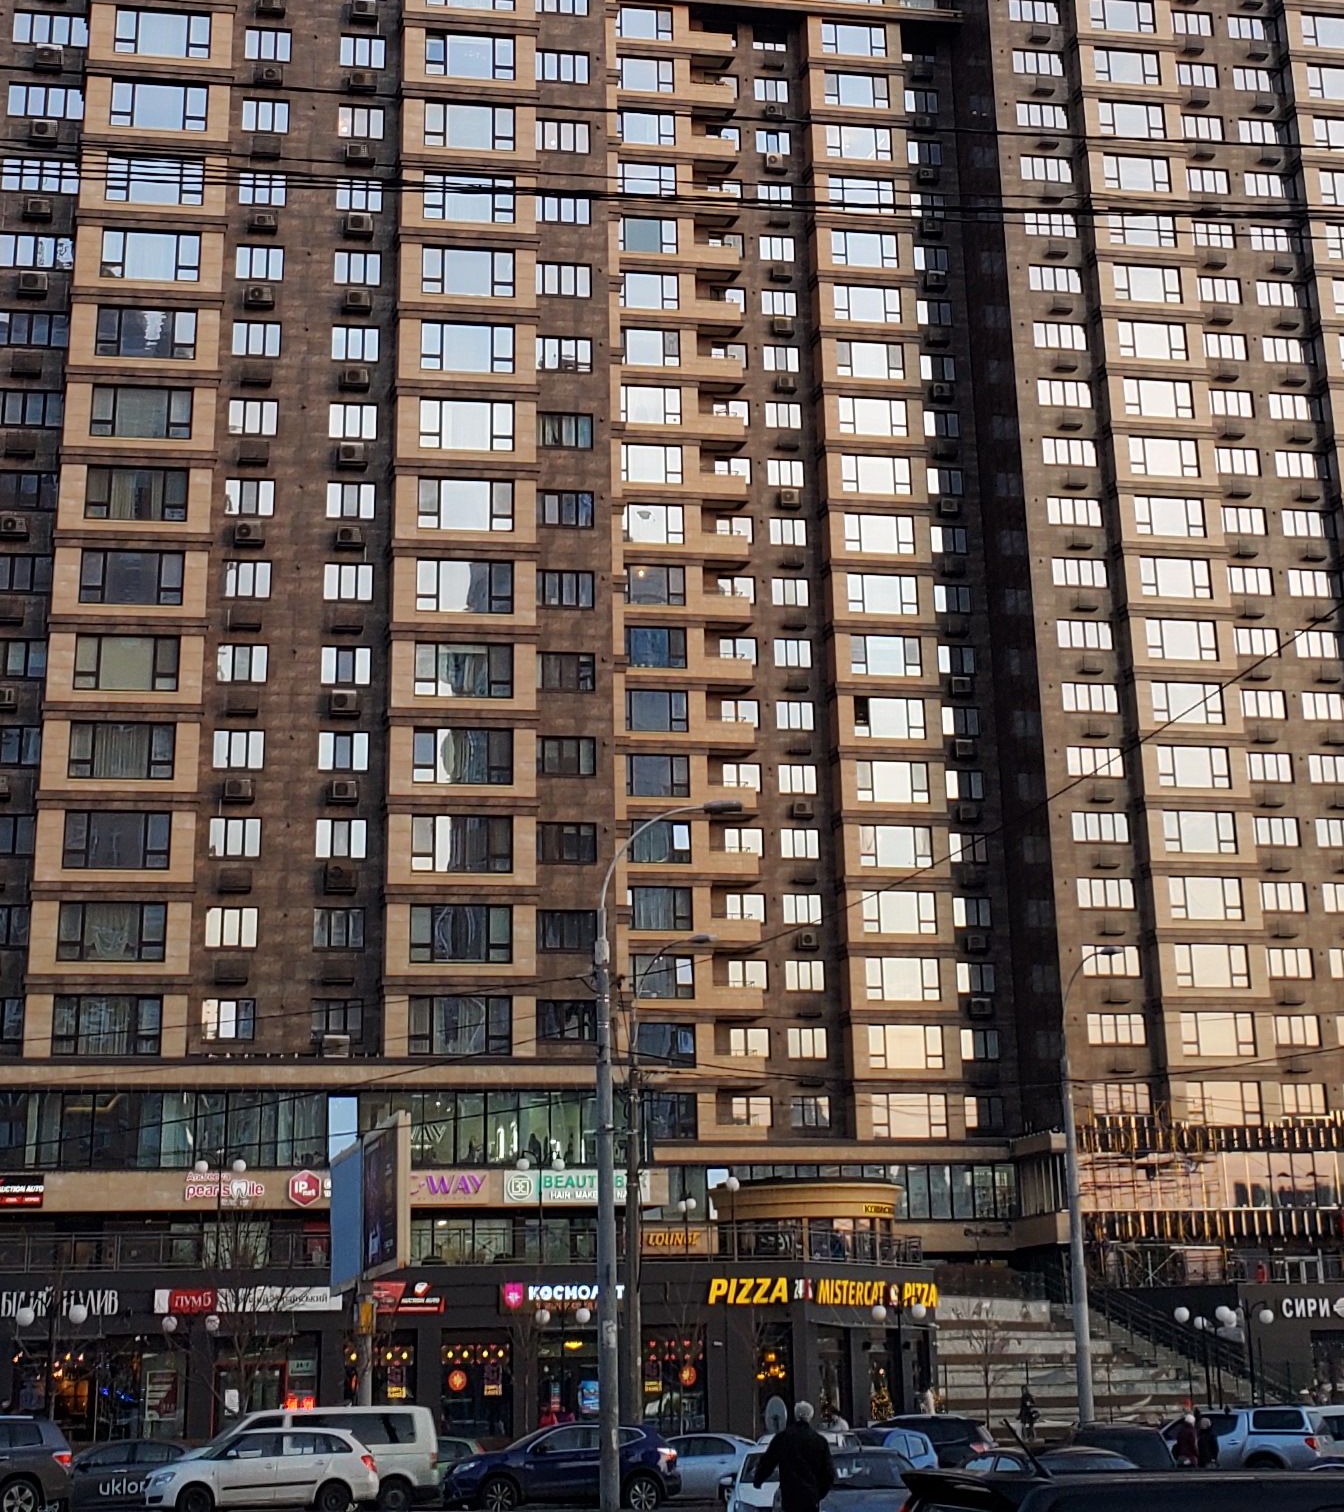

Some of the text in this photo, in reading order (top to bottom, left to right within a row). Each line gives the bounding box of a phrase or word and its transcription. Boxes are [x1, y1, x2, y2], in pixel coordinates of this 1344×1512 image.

[543, 1175, 597, 1189] BEAUT
[528, 1284, 625, 1300] КОСМОЛТ
[708, 1277, 788, 1305] PIZZA
[818, 1278, 938, 1307] MISTERCAT PIZZA
[1282, 1298, 1331, 1318] СИРИ
